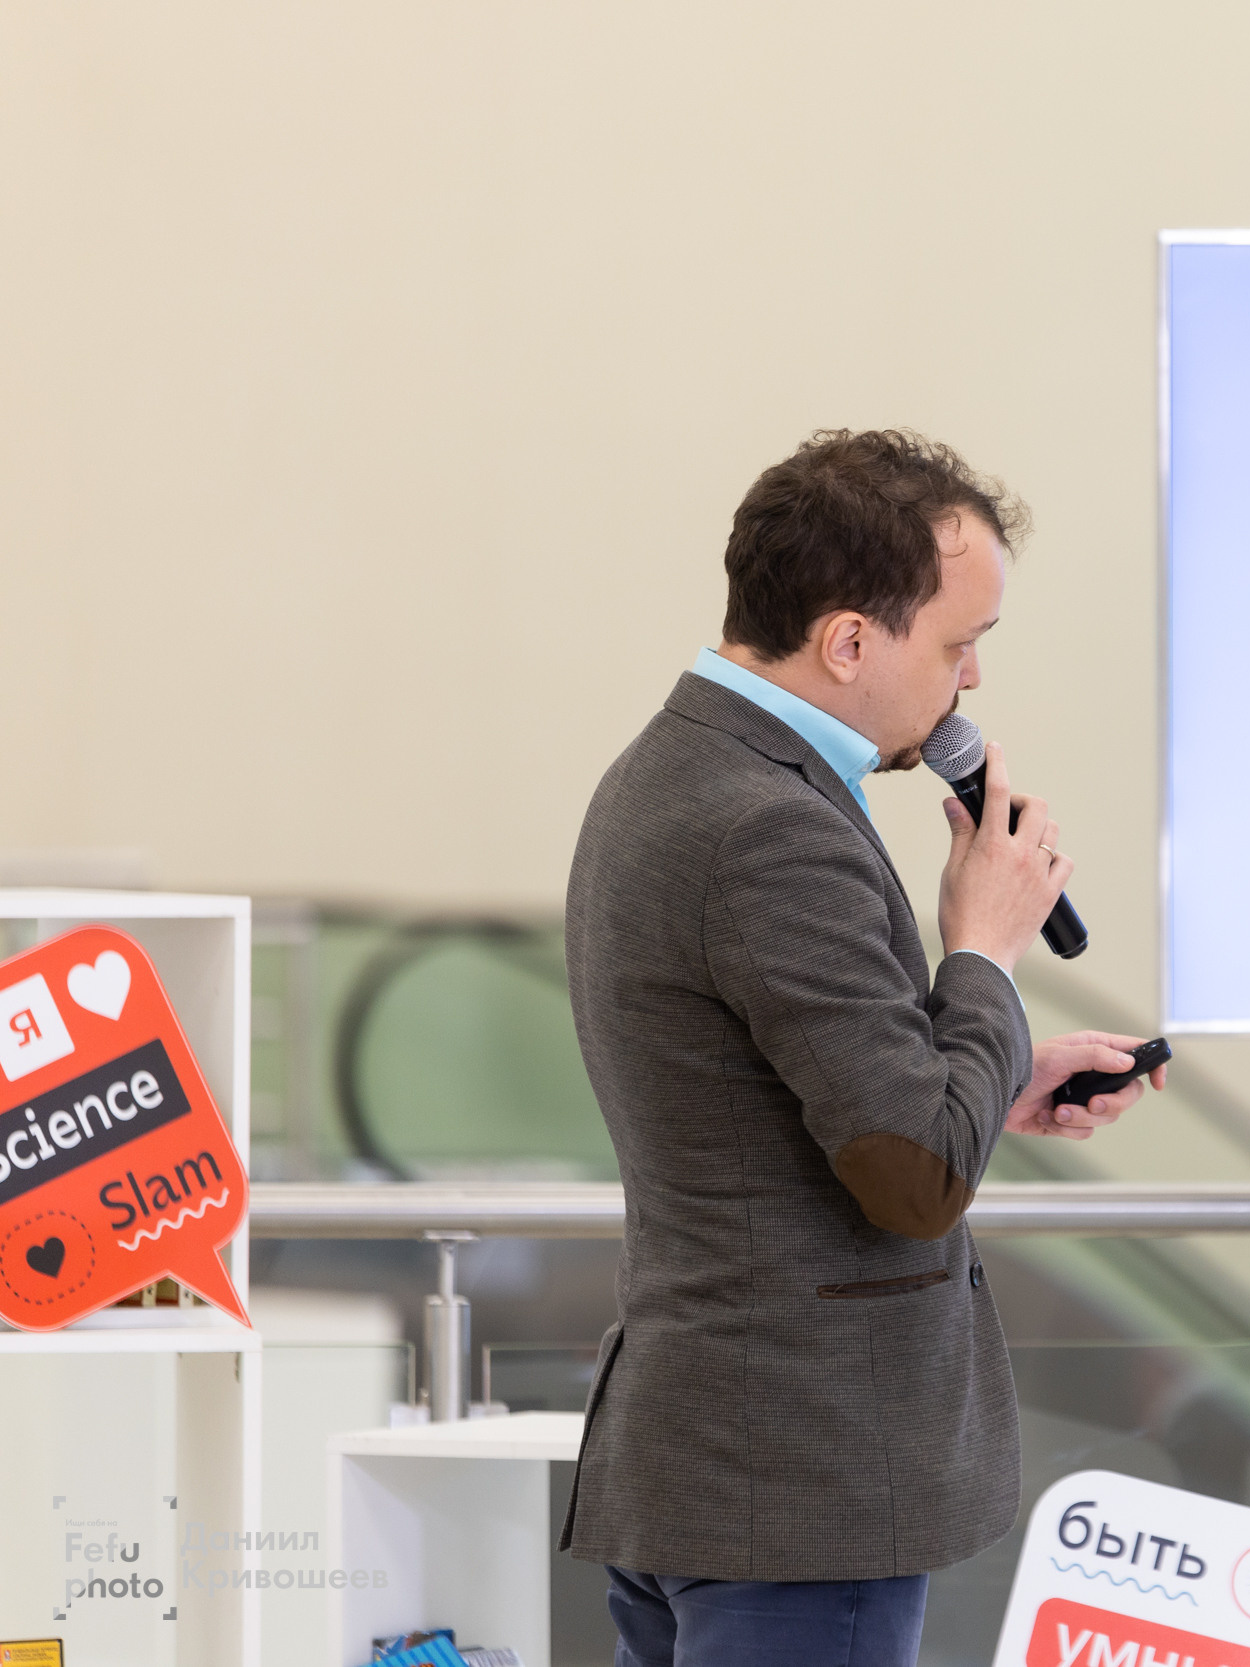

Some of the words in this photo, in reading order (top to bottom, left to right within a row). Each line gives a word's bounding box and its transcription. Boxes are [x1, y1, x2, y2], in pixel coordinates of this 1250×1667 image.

[9, 1008, 43, 1047] Я
[99, 1149, 224, 1230] Slam
[1056, 1500, 1208, 1580] быть
[1055, 1622, 1229, 1667] умн
